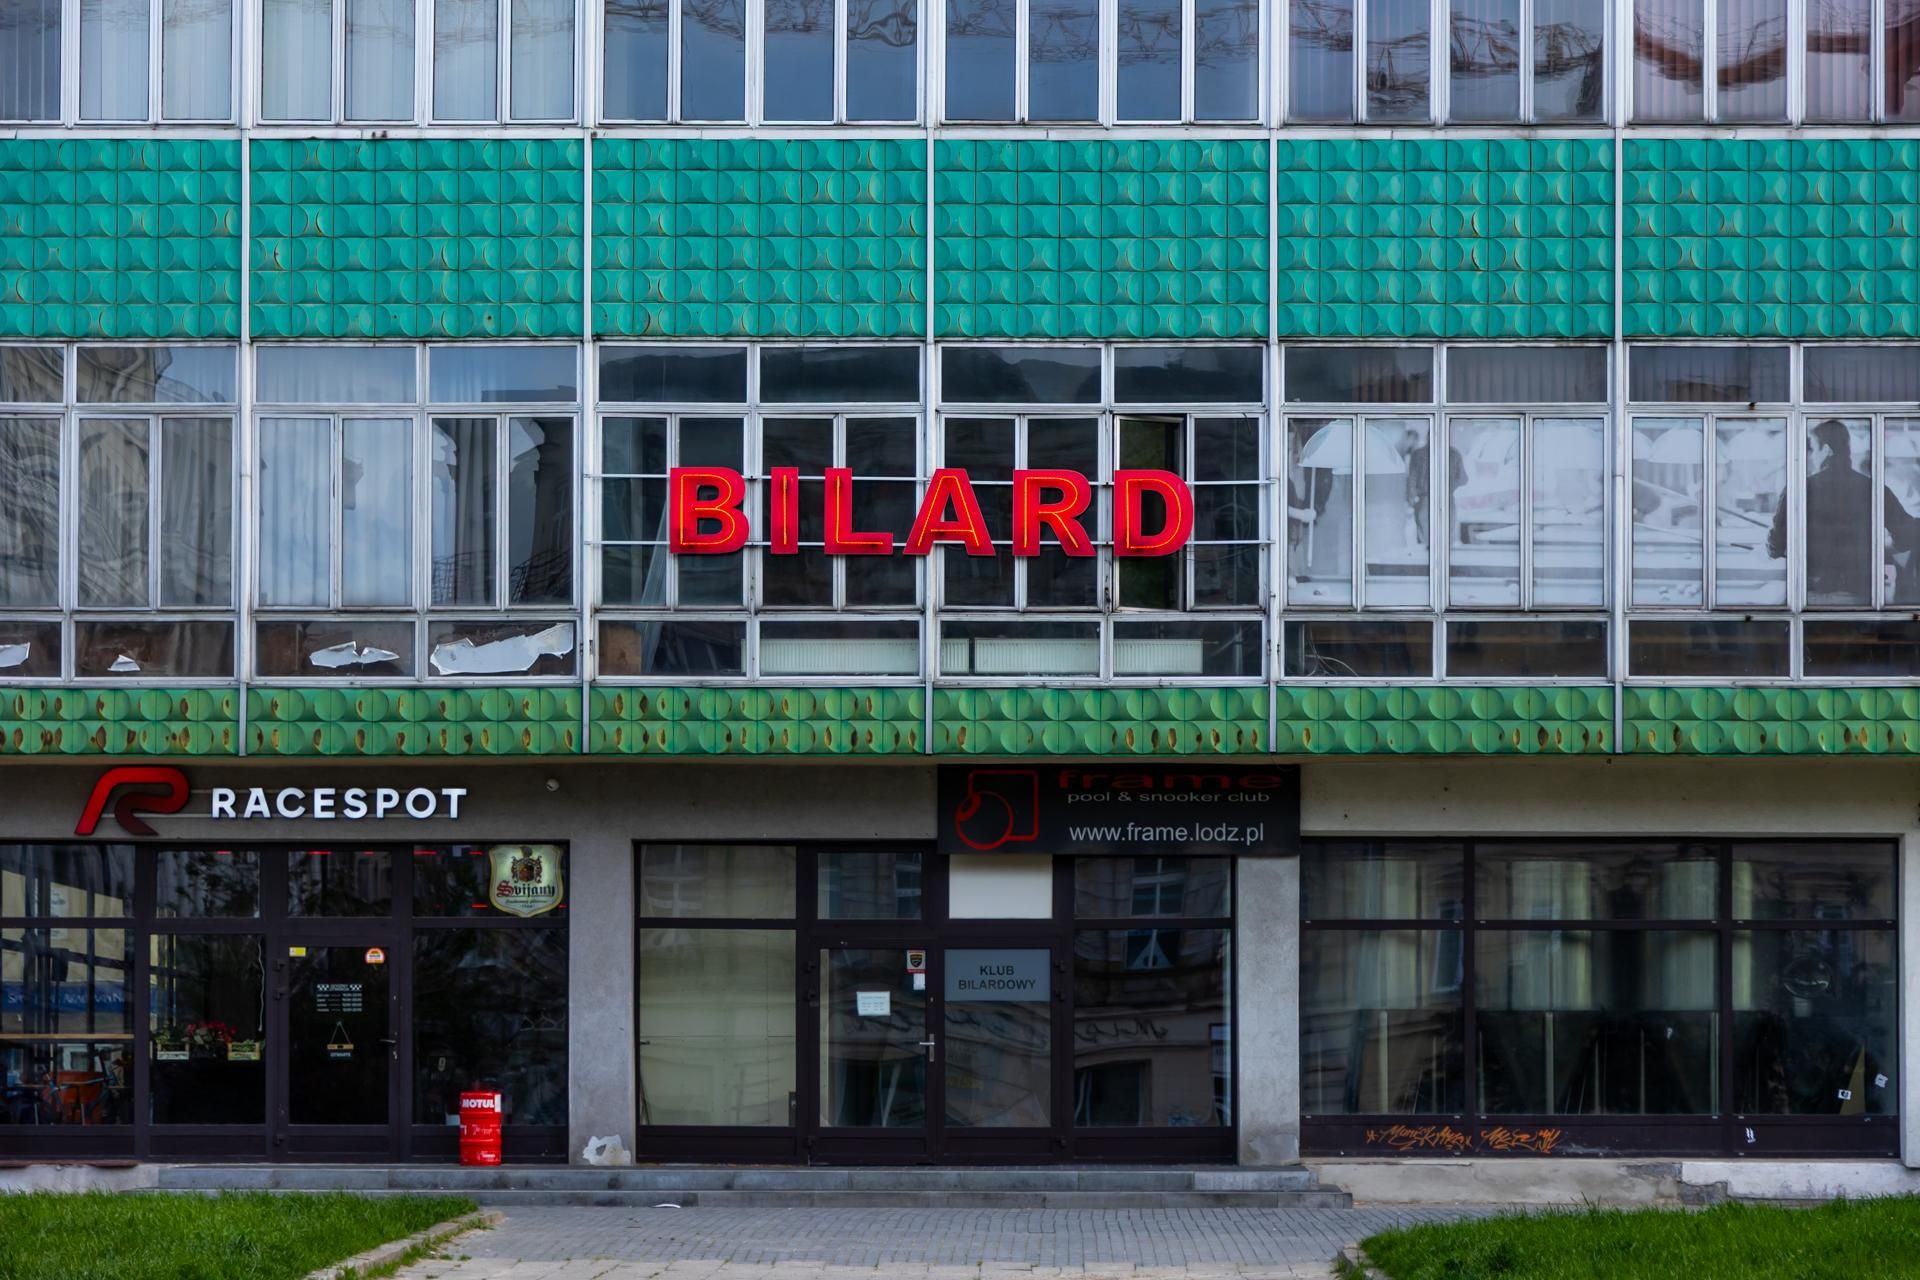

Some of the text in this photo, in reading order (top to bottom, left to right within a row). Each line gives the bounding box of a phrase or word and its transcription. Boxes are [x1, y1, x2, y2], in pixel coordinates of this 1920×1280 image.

[669, 467, 1195, 557] BILARD
[1058, 770, 1282, 789] frame
[212, 787, 467, 819] RACESPOT
[1068, 791, 1270, 804] pool & snooker club
[1069, 823, 1264, 845] www.frame.lodz.pl
[496, 880, 556, 897] Svijany
[979, 965, 1015, 976] KLUB
[958, 979, 1036, 990] BILARDOWY
[462, 1098, 495, 1108] MOTUL
